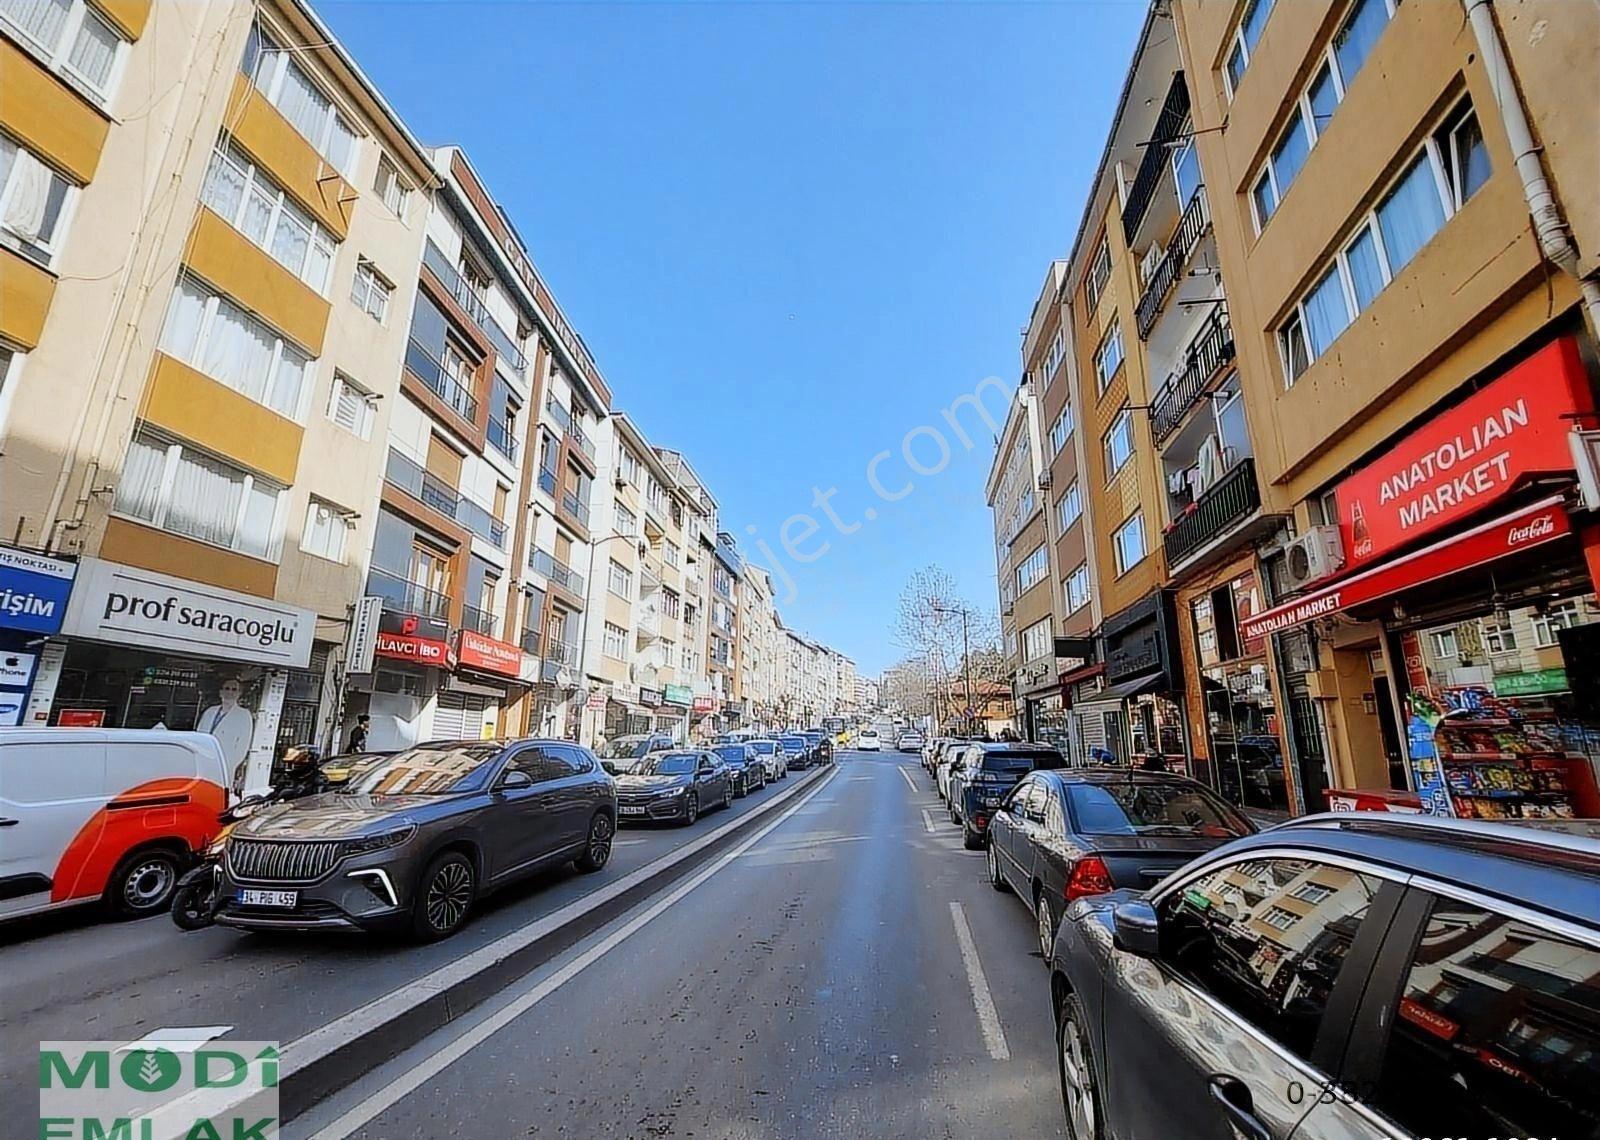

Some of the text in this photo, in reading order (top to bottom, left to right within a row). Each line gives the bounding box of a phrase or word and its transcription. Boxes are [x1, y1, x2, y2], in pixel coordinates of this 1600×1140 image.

[1378, 398, 1530, 506] ANATOLIAN
[1398, 452, 1511, 530] MARKET
[0, 589, 55, 617] İŞİM
[103, 592, 295, 646] prof saracoglu
[1246, 592, 1341, 638] ANATOLIAN MARKET
[376, 636, 417, 655] İLAVCI
